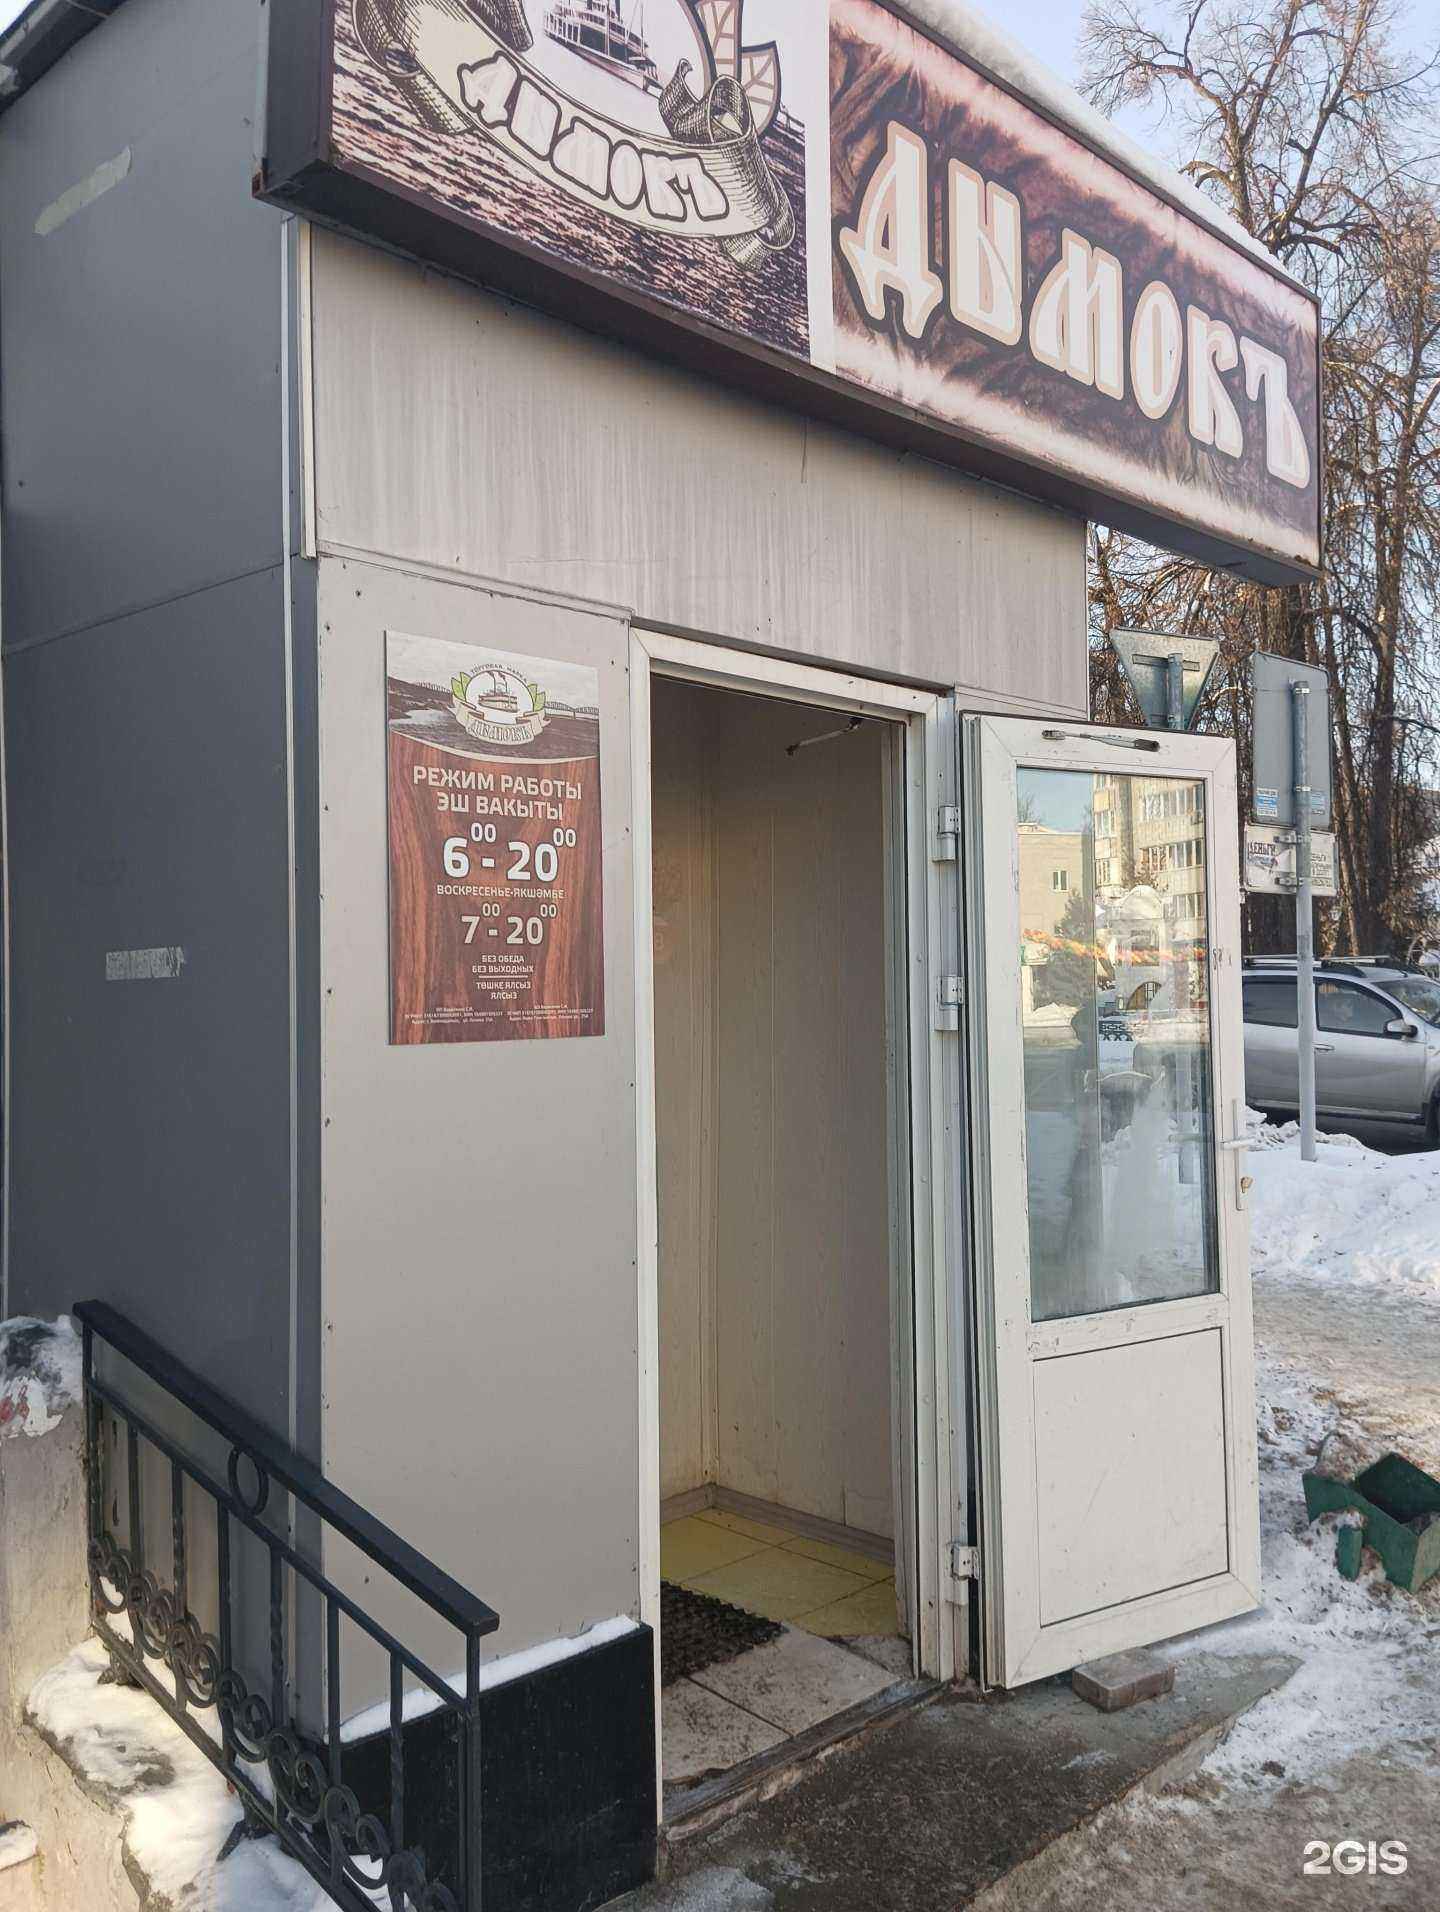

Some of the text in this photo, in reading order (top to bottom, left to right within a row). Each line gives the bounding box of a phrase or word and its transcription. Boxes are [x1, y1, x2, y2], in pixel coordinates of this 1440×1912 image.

[838, 119, 1312, 490] ДЫМОКЪ
[413, 765, 582, 800] РЕЖИМ РАБОТЫ
[436, 791, 563, 821] ЭШ ВАКЫТЫ
[481, 955, 525, 963] БЕЗ ОБЕДА
[472, 965, 534, 974] БЕЗ ВЫХОДНЫХ
[490, 991, 518, 1000] ЯЛСЫЗ
